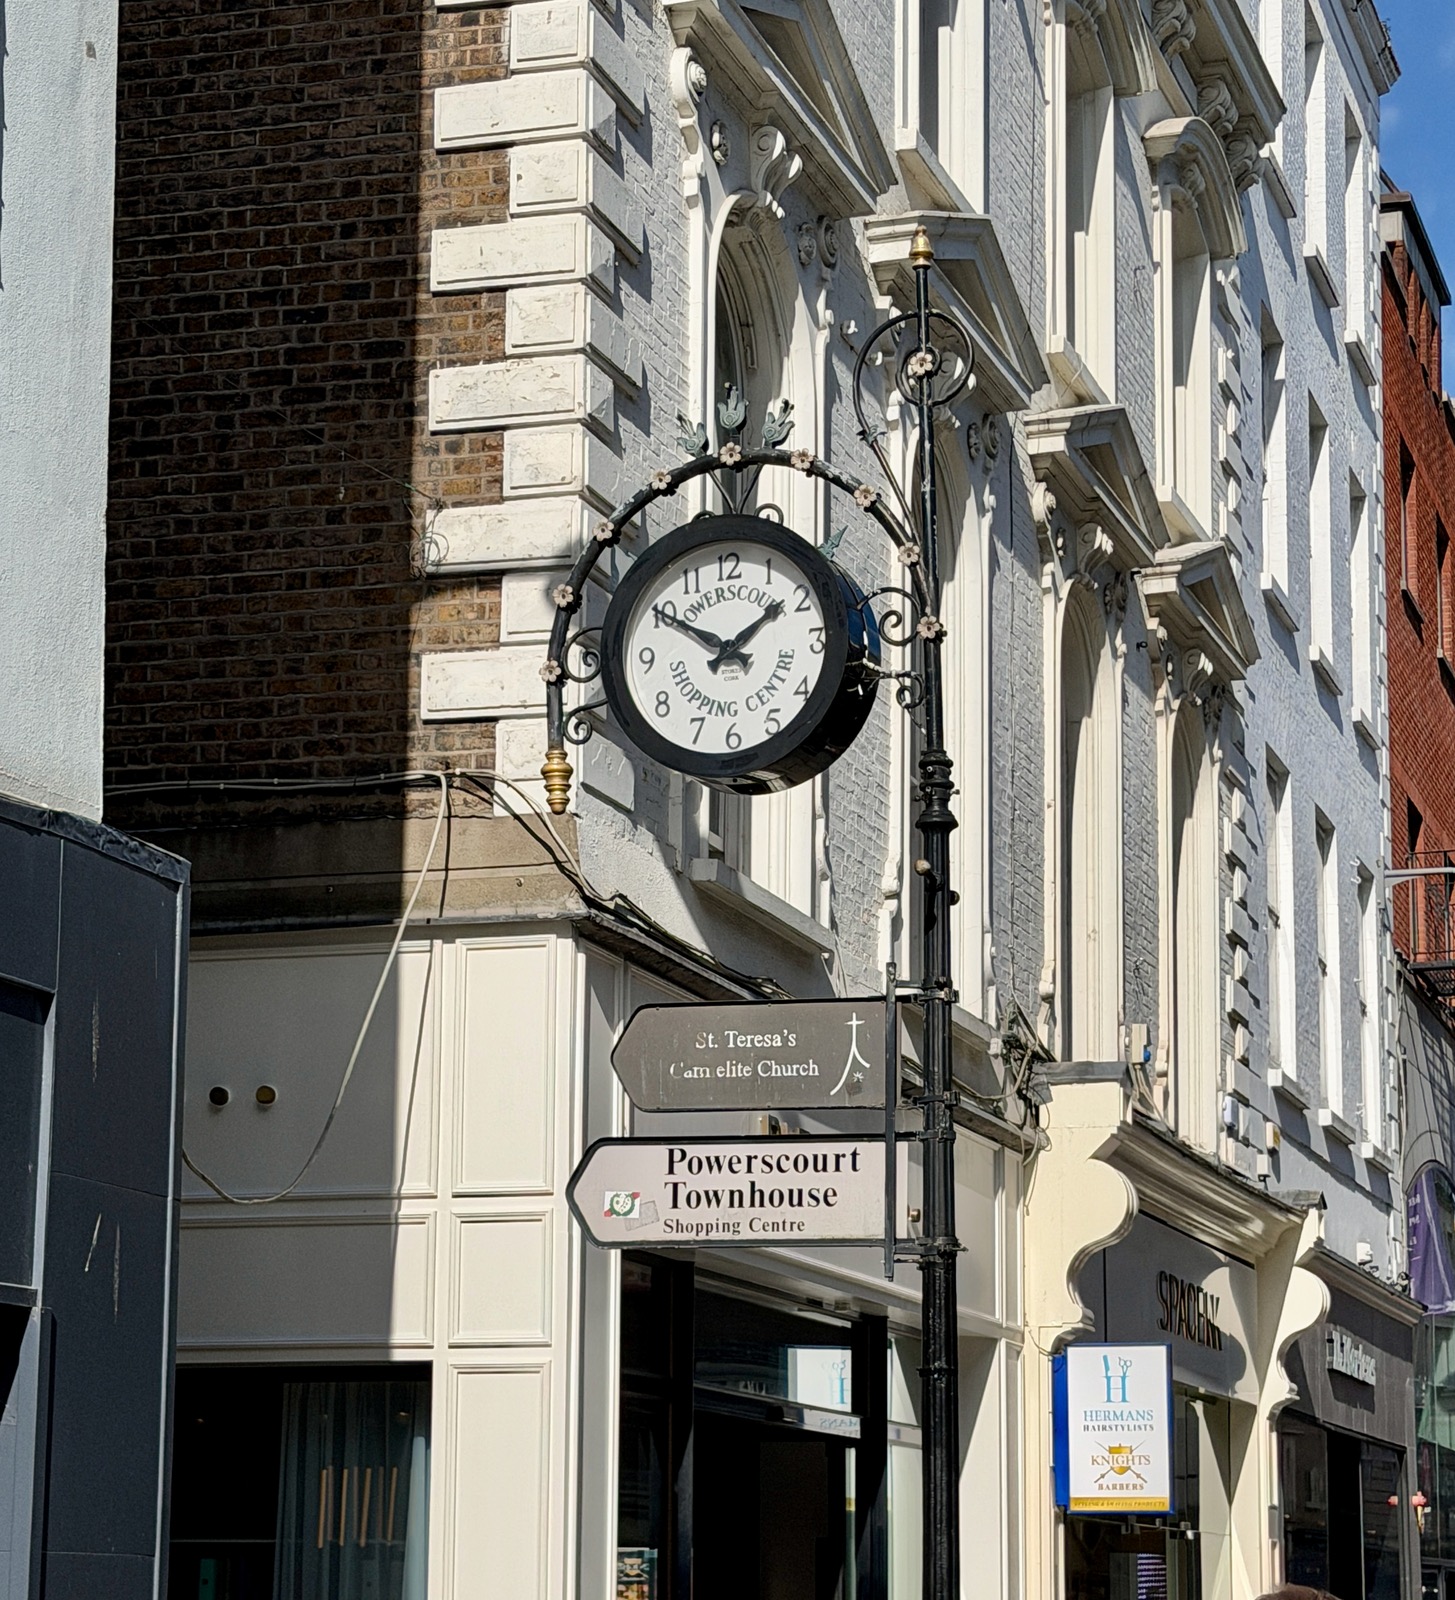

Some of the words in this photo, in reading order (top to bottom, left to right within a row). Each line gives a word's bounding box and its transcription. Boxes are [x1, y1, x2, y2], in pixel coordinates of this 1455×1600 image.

[682, 567, 701, 595] 11
[717, 552, 742, 582] 12
[765, 558, 773, 585] 1
[792, 584, 811, 613] 2
[652, 600, 677, 629] 10
[808, 627, 825, 655] 3
[638, 647, 656, 675] 9
[669, 660, 739, 718] SHOPPING
[745, 648, 795, 712] CENTRE
[793, 675, 810, 702] 4
[655, 690, 670, 718] 8
[689, 716, 706, 745] 7
[725, 722, 742, 750] 6
[764, 708, 782, 737] 5
[695, 1031, 718, 1048] St.
[757, 1060, 820, 1078] Church
[664, 1146, 861, 1176] Powerscourt
[663, 1180, 838, 1210] Townhouse
[662, 1217, 741, 1237] Shopping
[748, 1217, 806, 1233] Centre
[1083, 1409, 1153, 1422] HERMANS
[1083, 1424, 1154, 1432] HAIRSTYLISTS
[1091, 1454, 1151, 1466] KNIGHTS
[1098, 1483, 1145, 1491] BARBERS
